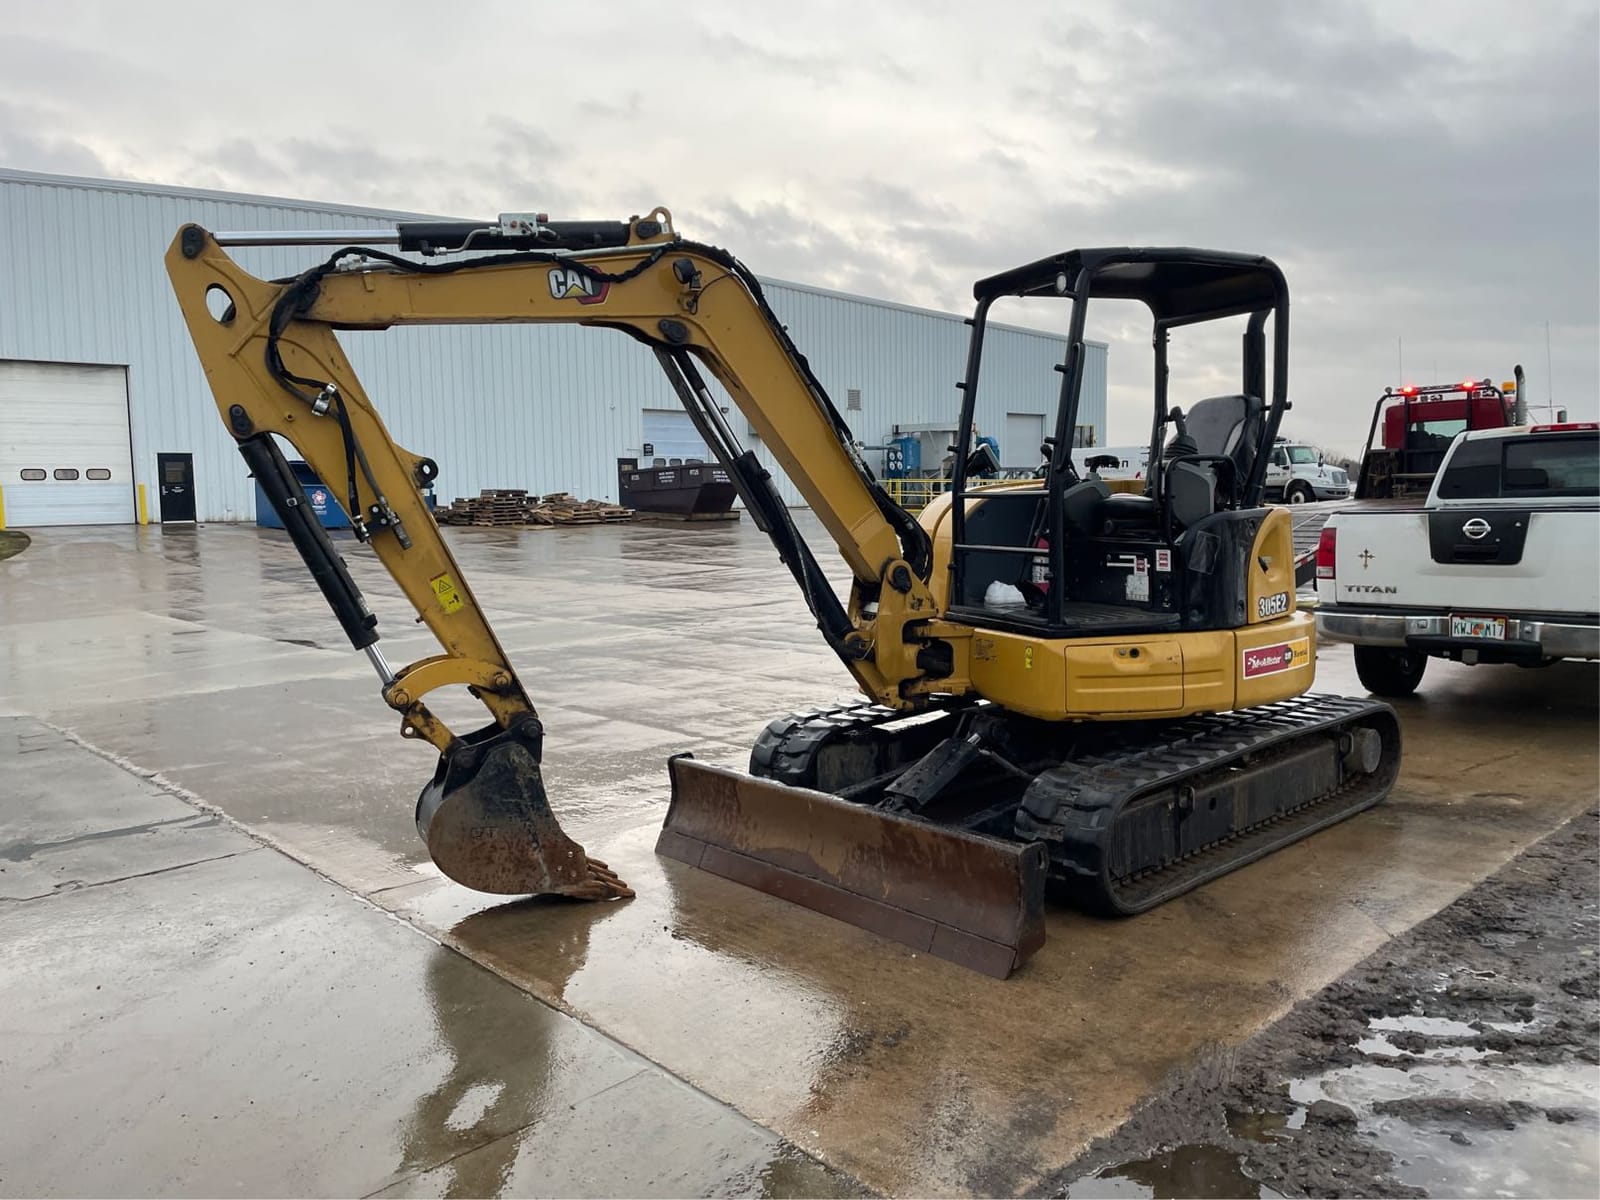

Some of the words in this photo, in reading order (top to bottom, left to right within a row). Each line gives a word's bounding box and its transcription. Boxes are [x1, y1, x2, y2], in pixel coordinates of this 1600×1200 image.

[1344, 584, 1397, 594] TITAN
[1259, 593, 1287, 617] 305E2
[1453, 621, 1473, 635] KWJ
